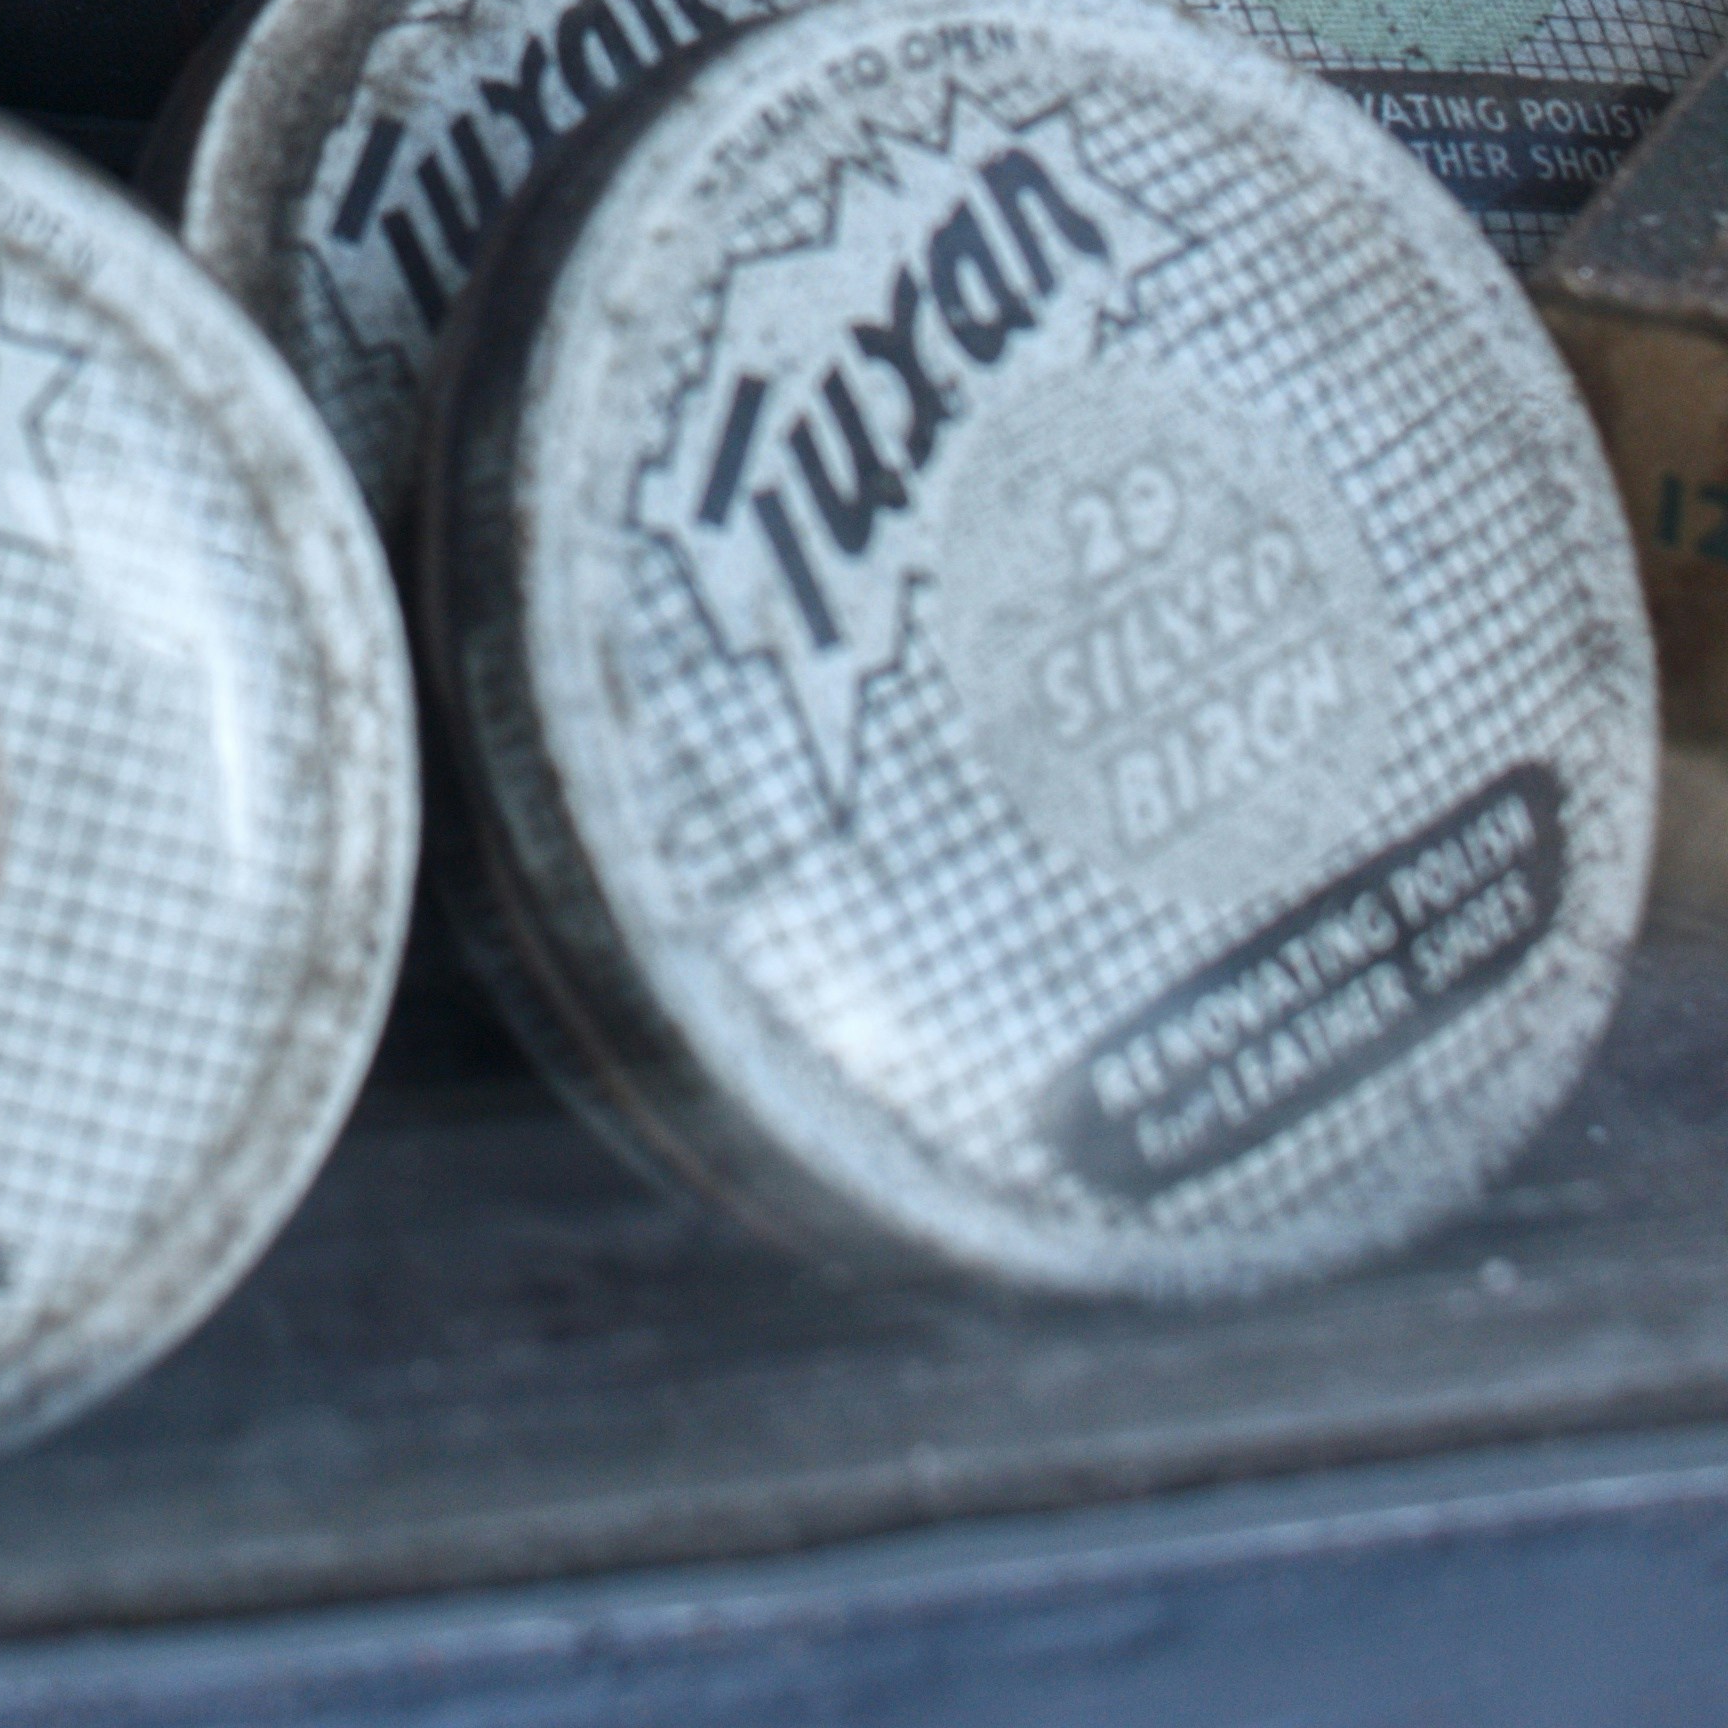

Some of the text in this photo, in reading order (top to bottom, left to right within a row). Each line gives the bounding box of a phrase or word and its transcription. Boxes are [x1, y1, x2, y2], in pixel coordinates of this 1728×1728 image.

[1362, 92, 1508, 133] ATING
[1409, 140, 1622, 182] THER SHO
[698, 144, 1113, 654] Tuxan
[1116, 640, 1342, 842] BIRCH
